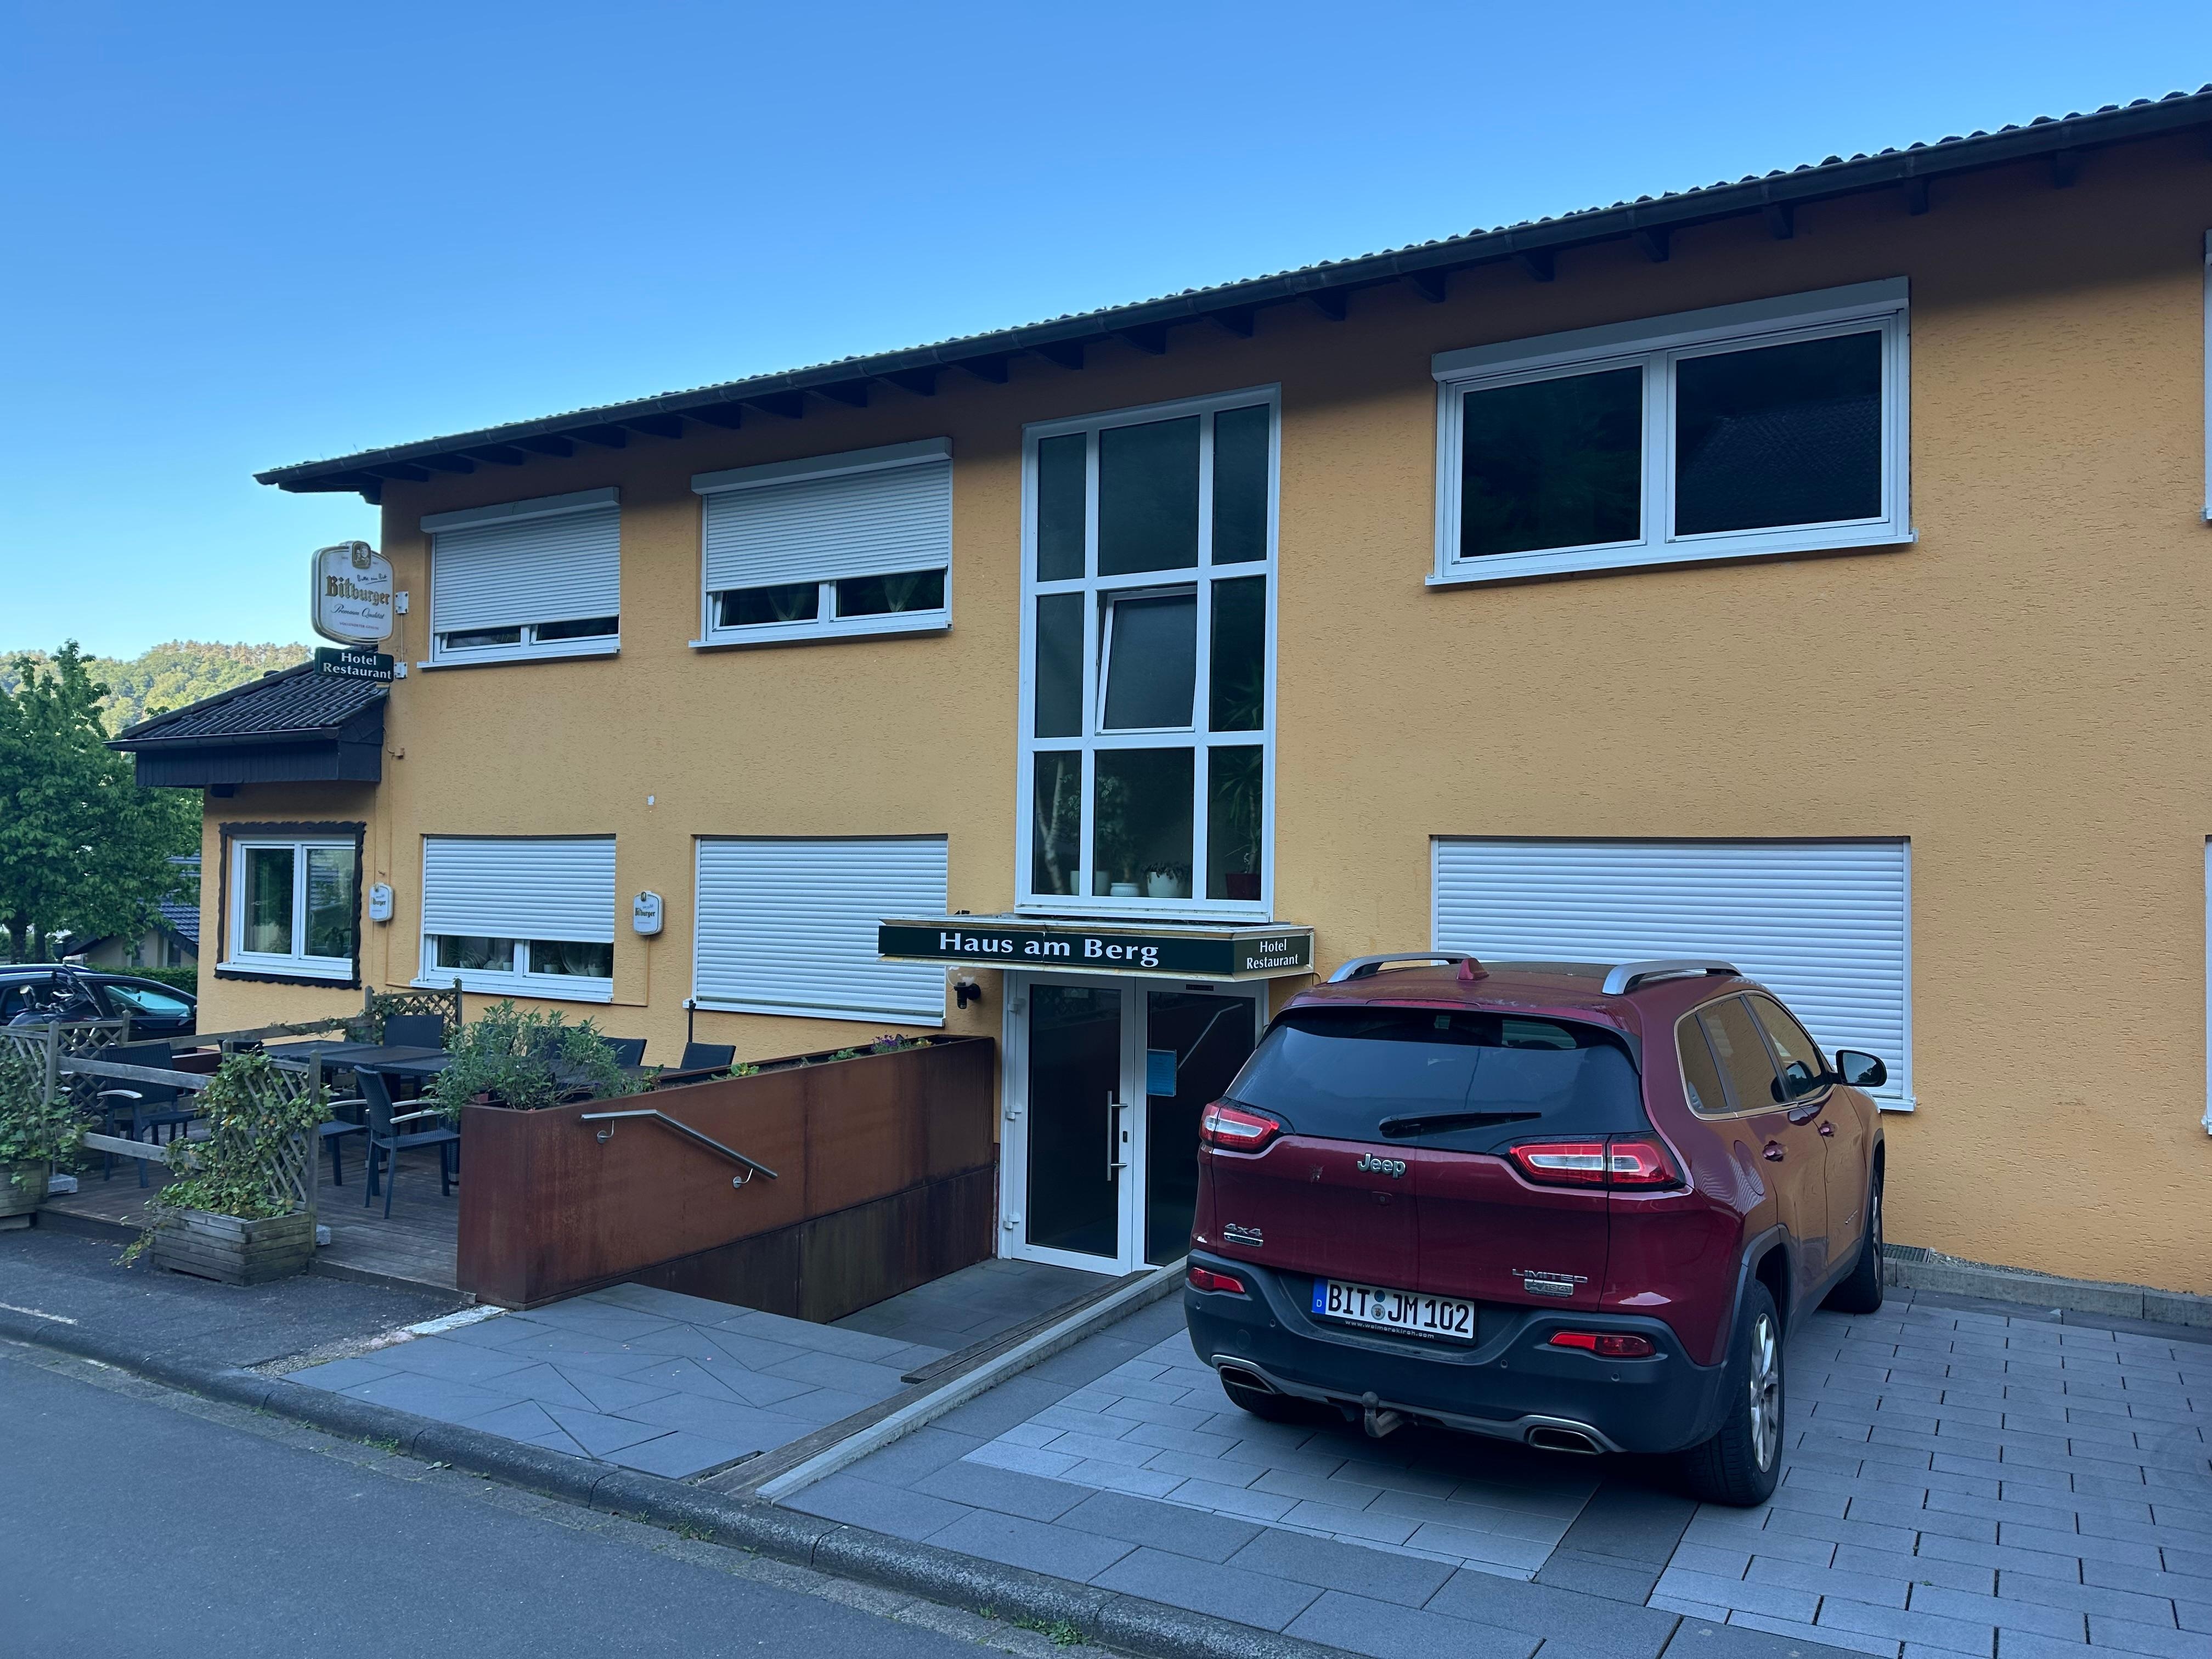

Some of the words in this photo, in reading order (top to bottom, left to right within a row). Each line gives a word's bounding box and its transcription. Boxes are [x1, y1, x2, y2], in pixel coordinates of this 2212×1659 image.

[325, 575, 390, 606] Bitburger
[331, 603, 359, 615] Premium
[341, 652, 376, 665] Hotel
[323, 663, 391, 679] Restaurant
[940, 932, 1013, 953] Haus
[1024, 940, 1070, 956] am
[1084, 939, 1159, 967] Berg
[1260, 939, 1286, 953] Hotel
[1246, 954, 1298, 969] Restaurant
[1357, 1153, 1406, 1178] Jeep
[1512, 1268, 1588, 1283] LIMITED
[1546, 1284, 1570, 1293] 1941
[1317, 1299, 1322, 1307] D
[1328, 1284, 1370, 1316] BIT
[1388, 1294, 1418, 1325] JM
[1424, 1299, 1469, 1333] 102
